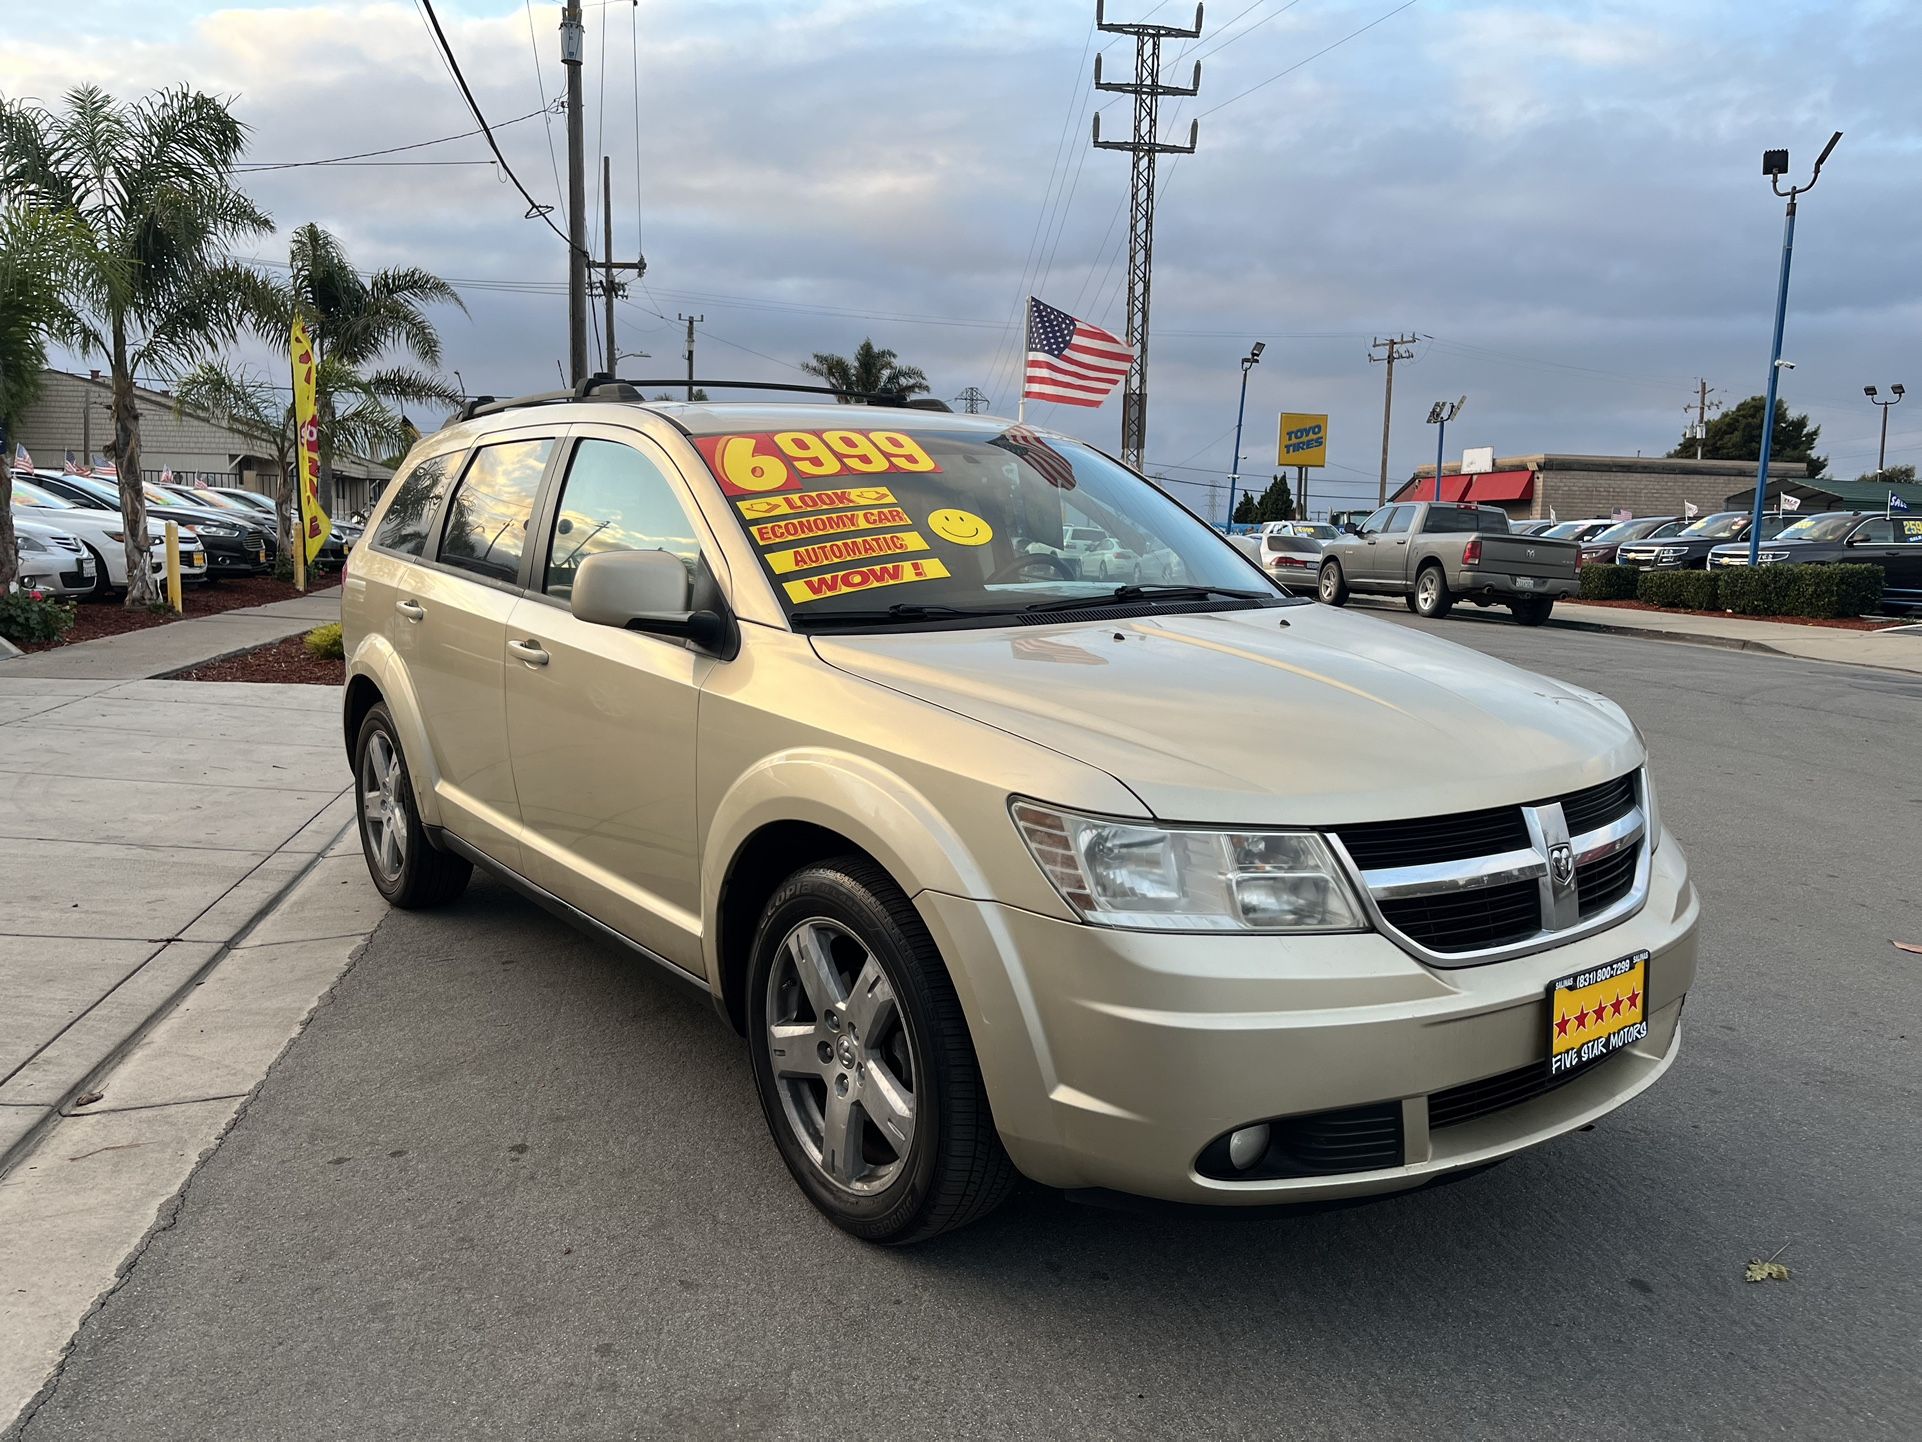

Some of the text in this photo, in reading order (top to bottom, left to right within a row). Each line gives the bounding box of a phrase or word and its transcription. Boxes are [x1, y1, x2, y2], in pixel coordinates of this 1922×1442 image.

[1285, 436, 1323, 454] TIRES
[1286, 424, 1322, 441] TOYO
[716, 430, 936, 491] 6999
[783, 490, 858, 512] LOOK
[757, 508, 906, 542] ECONOMY CAR
[793, 535, 909, 567] AUTOMATIC
[804, 563, 904, 596] WOW
[1552, 1021, 1647, 1074] FIVE STAR MOTORS
